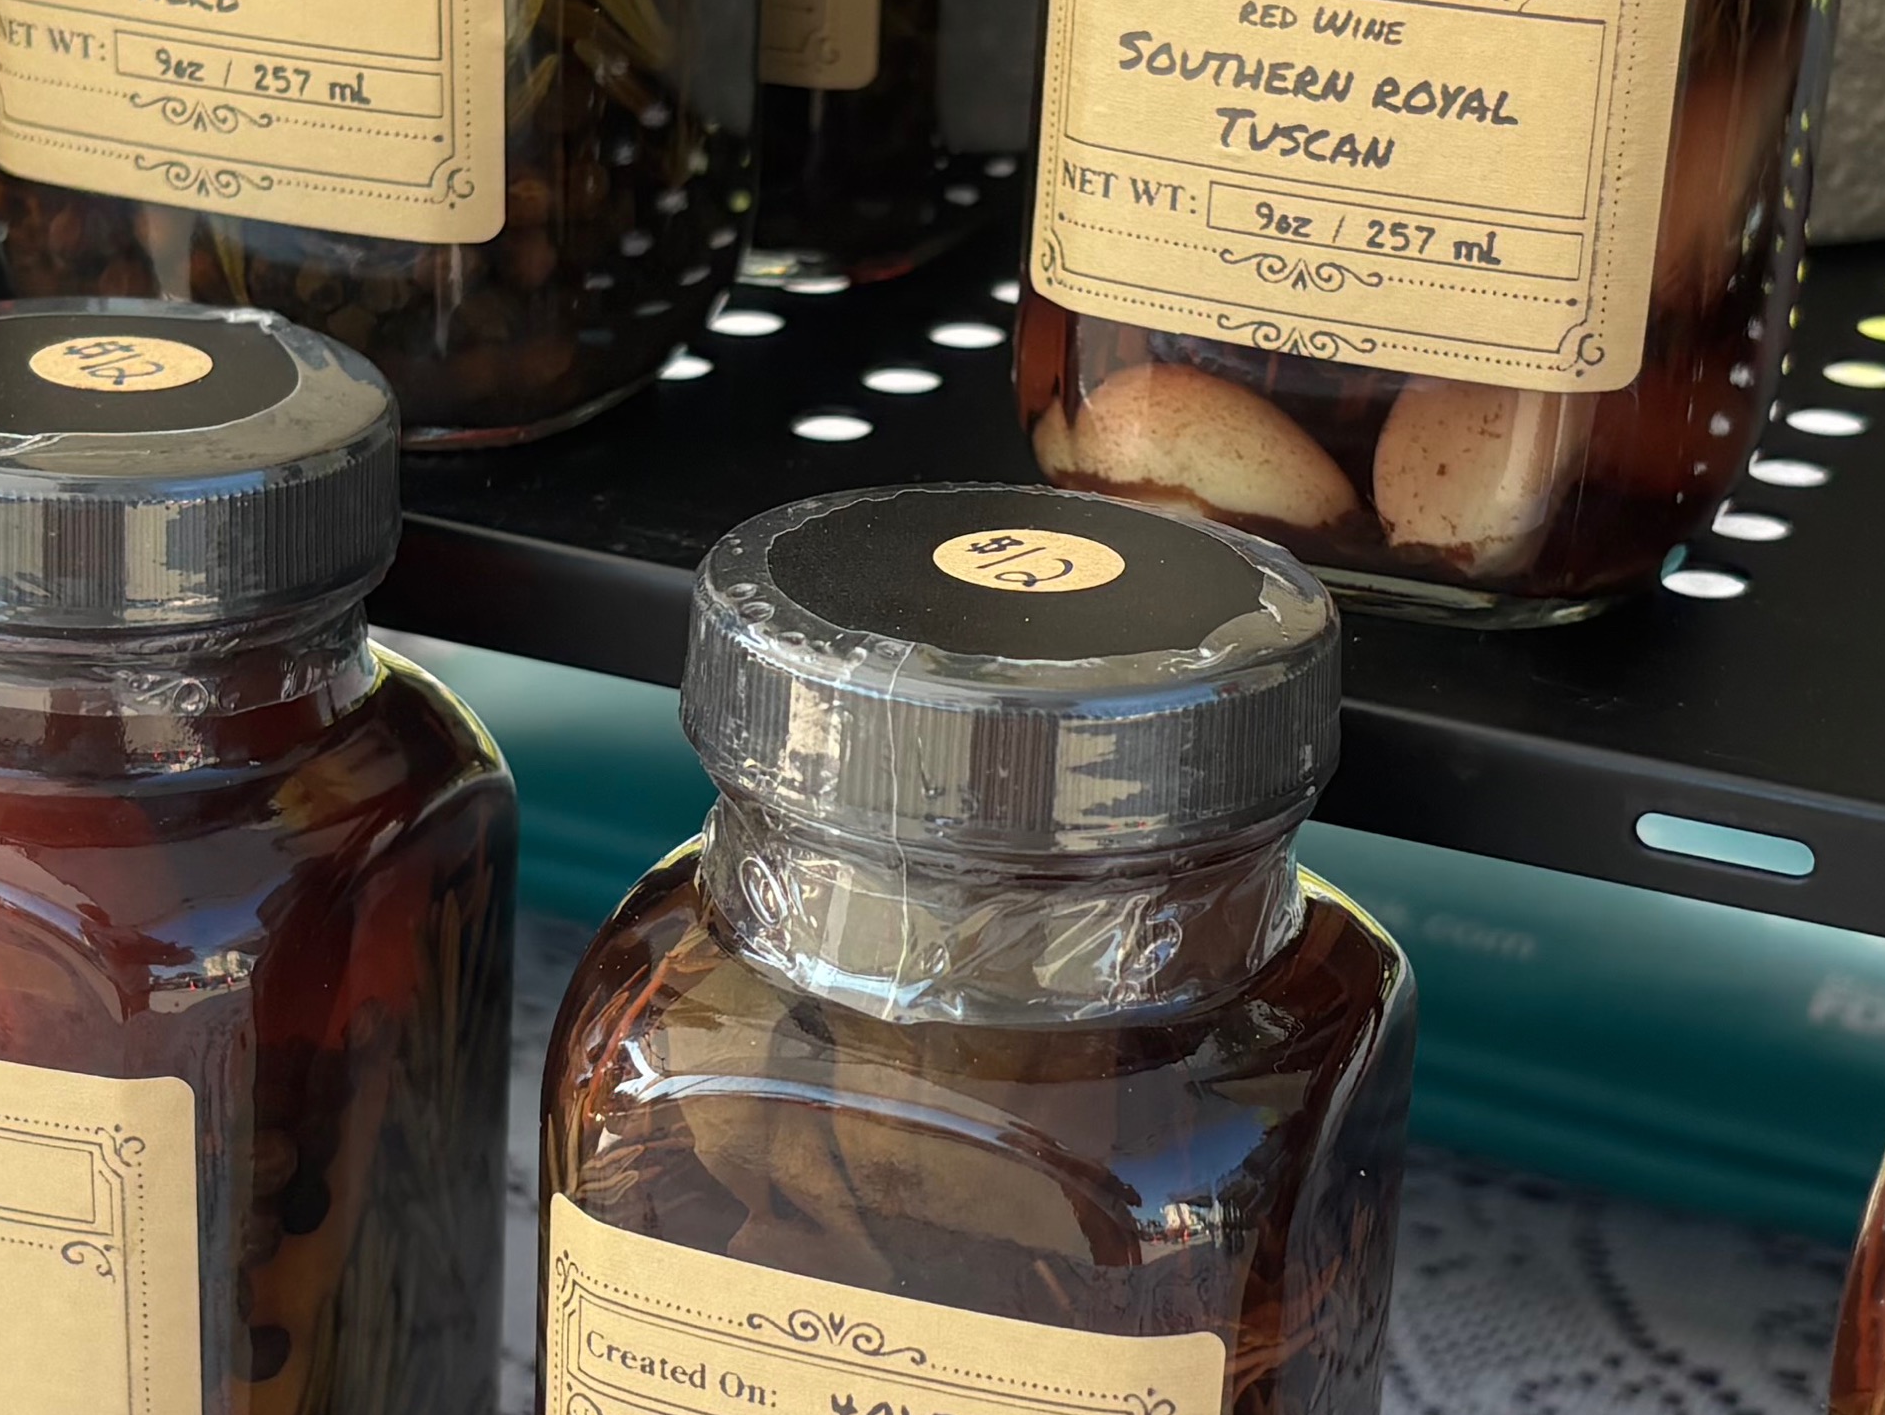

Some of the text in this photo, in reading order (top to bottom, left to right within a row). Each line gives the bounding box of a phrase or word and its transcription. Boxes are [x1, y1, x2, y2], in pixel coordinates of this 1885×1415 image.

[1239, 0, 1406, 47] RED WINE
[47, 27, 106, 61] WT:
[254, 63, 311, 97] 257
[1118, 30, 1519, 127] SOUTHERN ROYAL
[1215, 107, 1396, 169] TUSCAN
[1061, 161, 1119, 200] NET
[1130, 178, 1198, 215] WT:
[1366, 219, 1436, 254] 257
[966, 535, 1074, 588] $12
[585, 1330, 708, 1391] Created
[720, 1370, 778, 1408] On:
